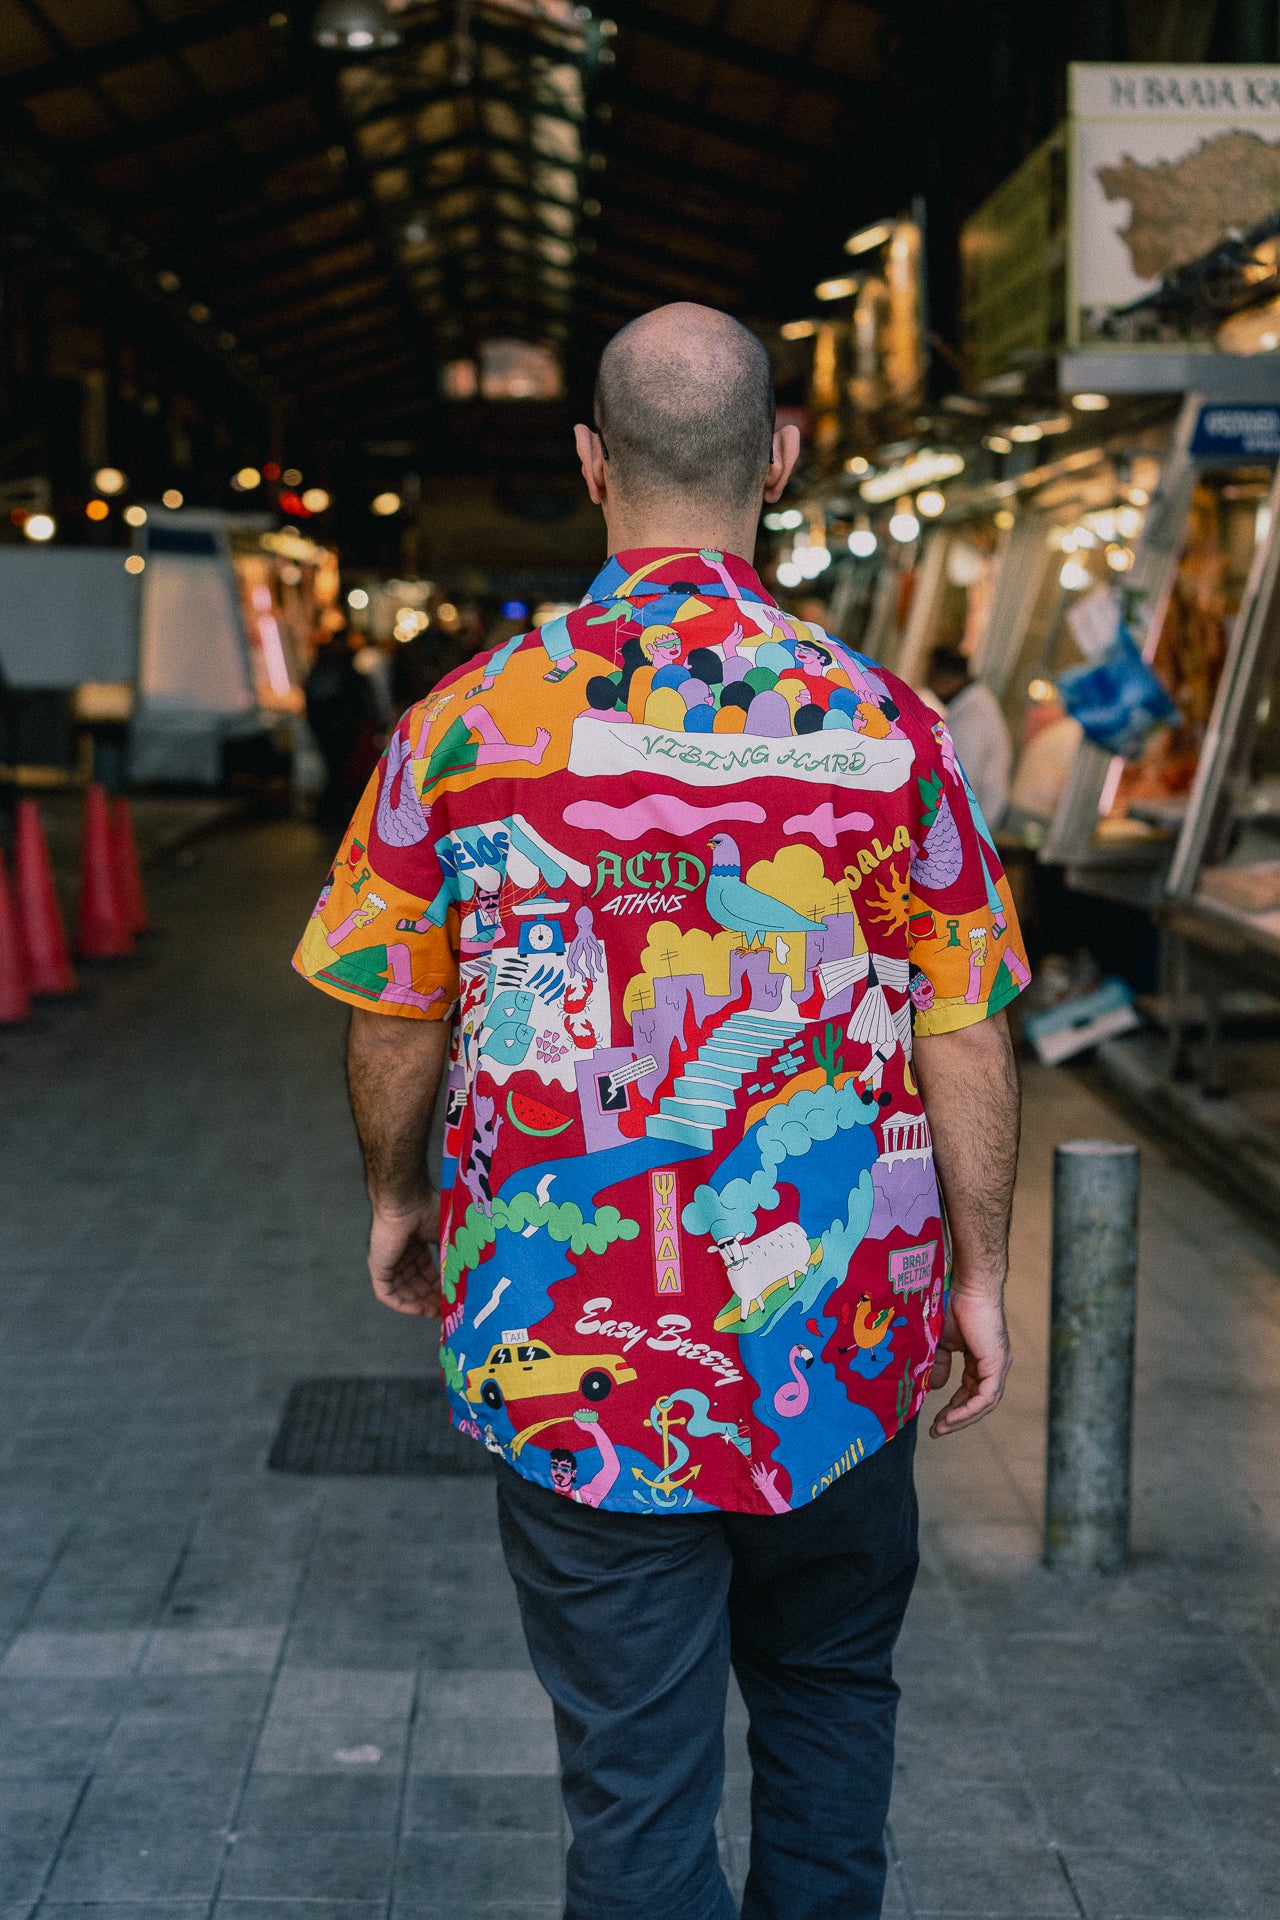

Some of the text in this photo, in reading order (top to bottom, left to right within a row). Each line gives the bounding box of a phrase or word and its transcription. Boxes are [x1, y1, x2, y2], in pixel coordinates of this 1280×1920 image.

[643, 734, 866, 773] VIBING HARD
[590, 849, 706, 898] ACID
[600, 891, 687, 916] ATHENS
[902, 1250, 929, 1271] BRAIN
[897, 1265, 931, 1287] MELTING
[503, 1331, 526, 1343] TAXI
[574, 1297, 744, 1387] Easy Breezy
